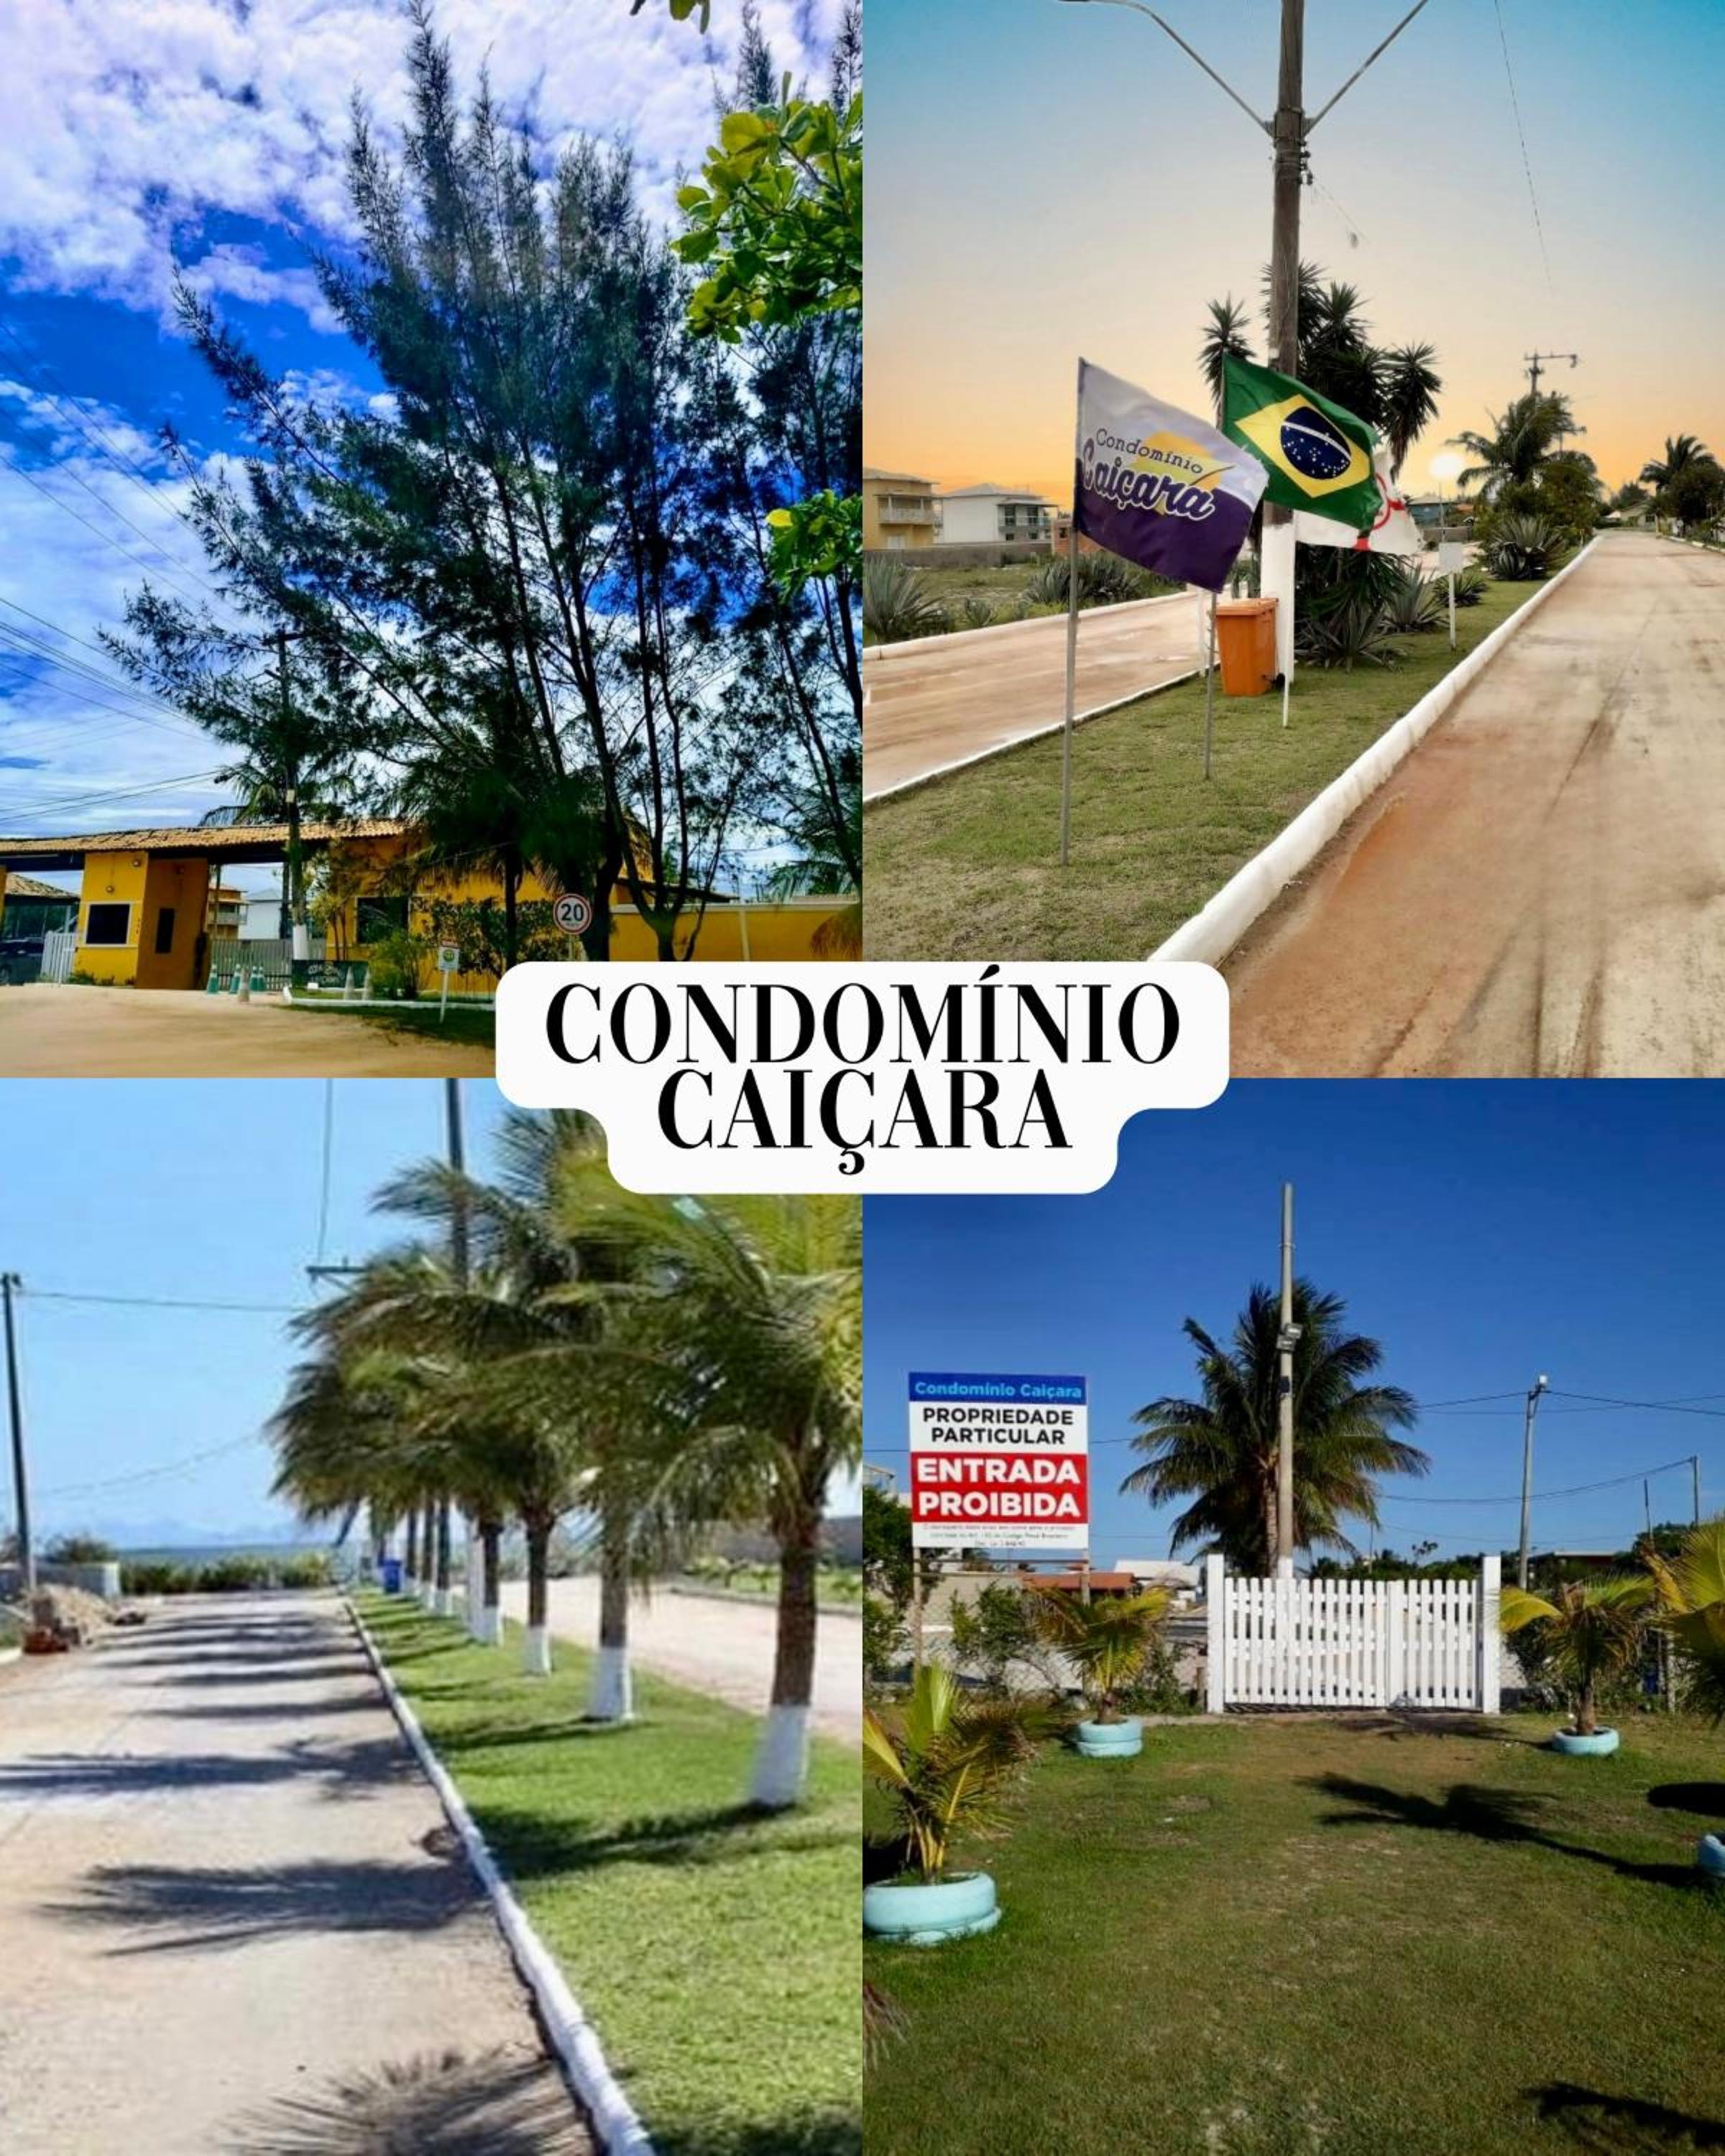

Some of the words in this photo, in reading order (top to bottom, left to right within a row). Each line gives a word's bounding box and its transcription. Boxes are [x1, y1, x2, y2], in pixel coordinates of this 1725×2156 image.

[1096, 428, 1203, 474] Condomínio
[1082, 438, 1215, 521] Caiçara
[561, 903, 584, 921] 20
[914, 1381, 1016, 1397] Condomínio
[1020, 1383, 1082, 1400] Caiçara
[923, 1407, 1074, 1425] PROPRIEDADE
[932, 1427, 1065, 1445] PARTICULAR
[916, 1457, 1081, 1484] ENTRADA
[918, 1491, 1081, 1518] PROIBIDA
